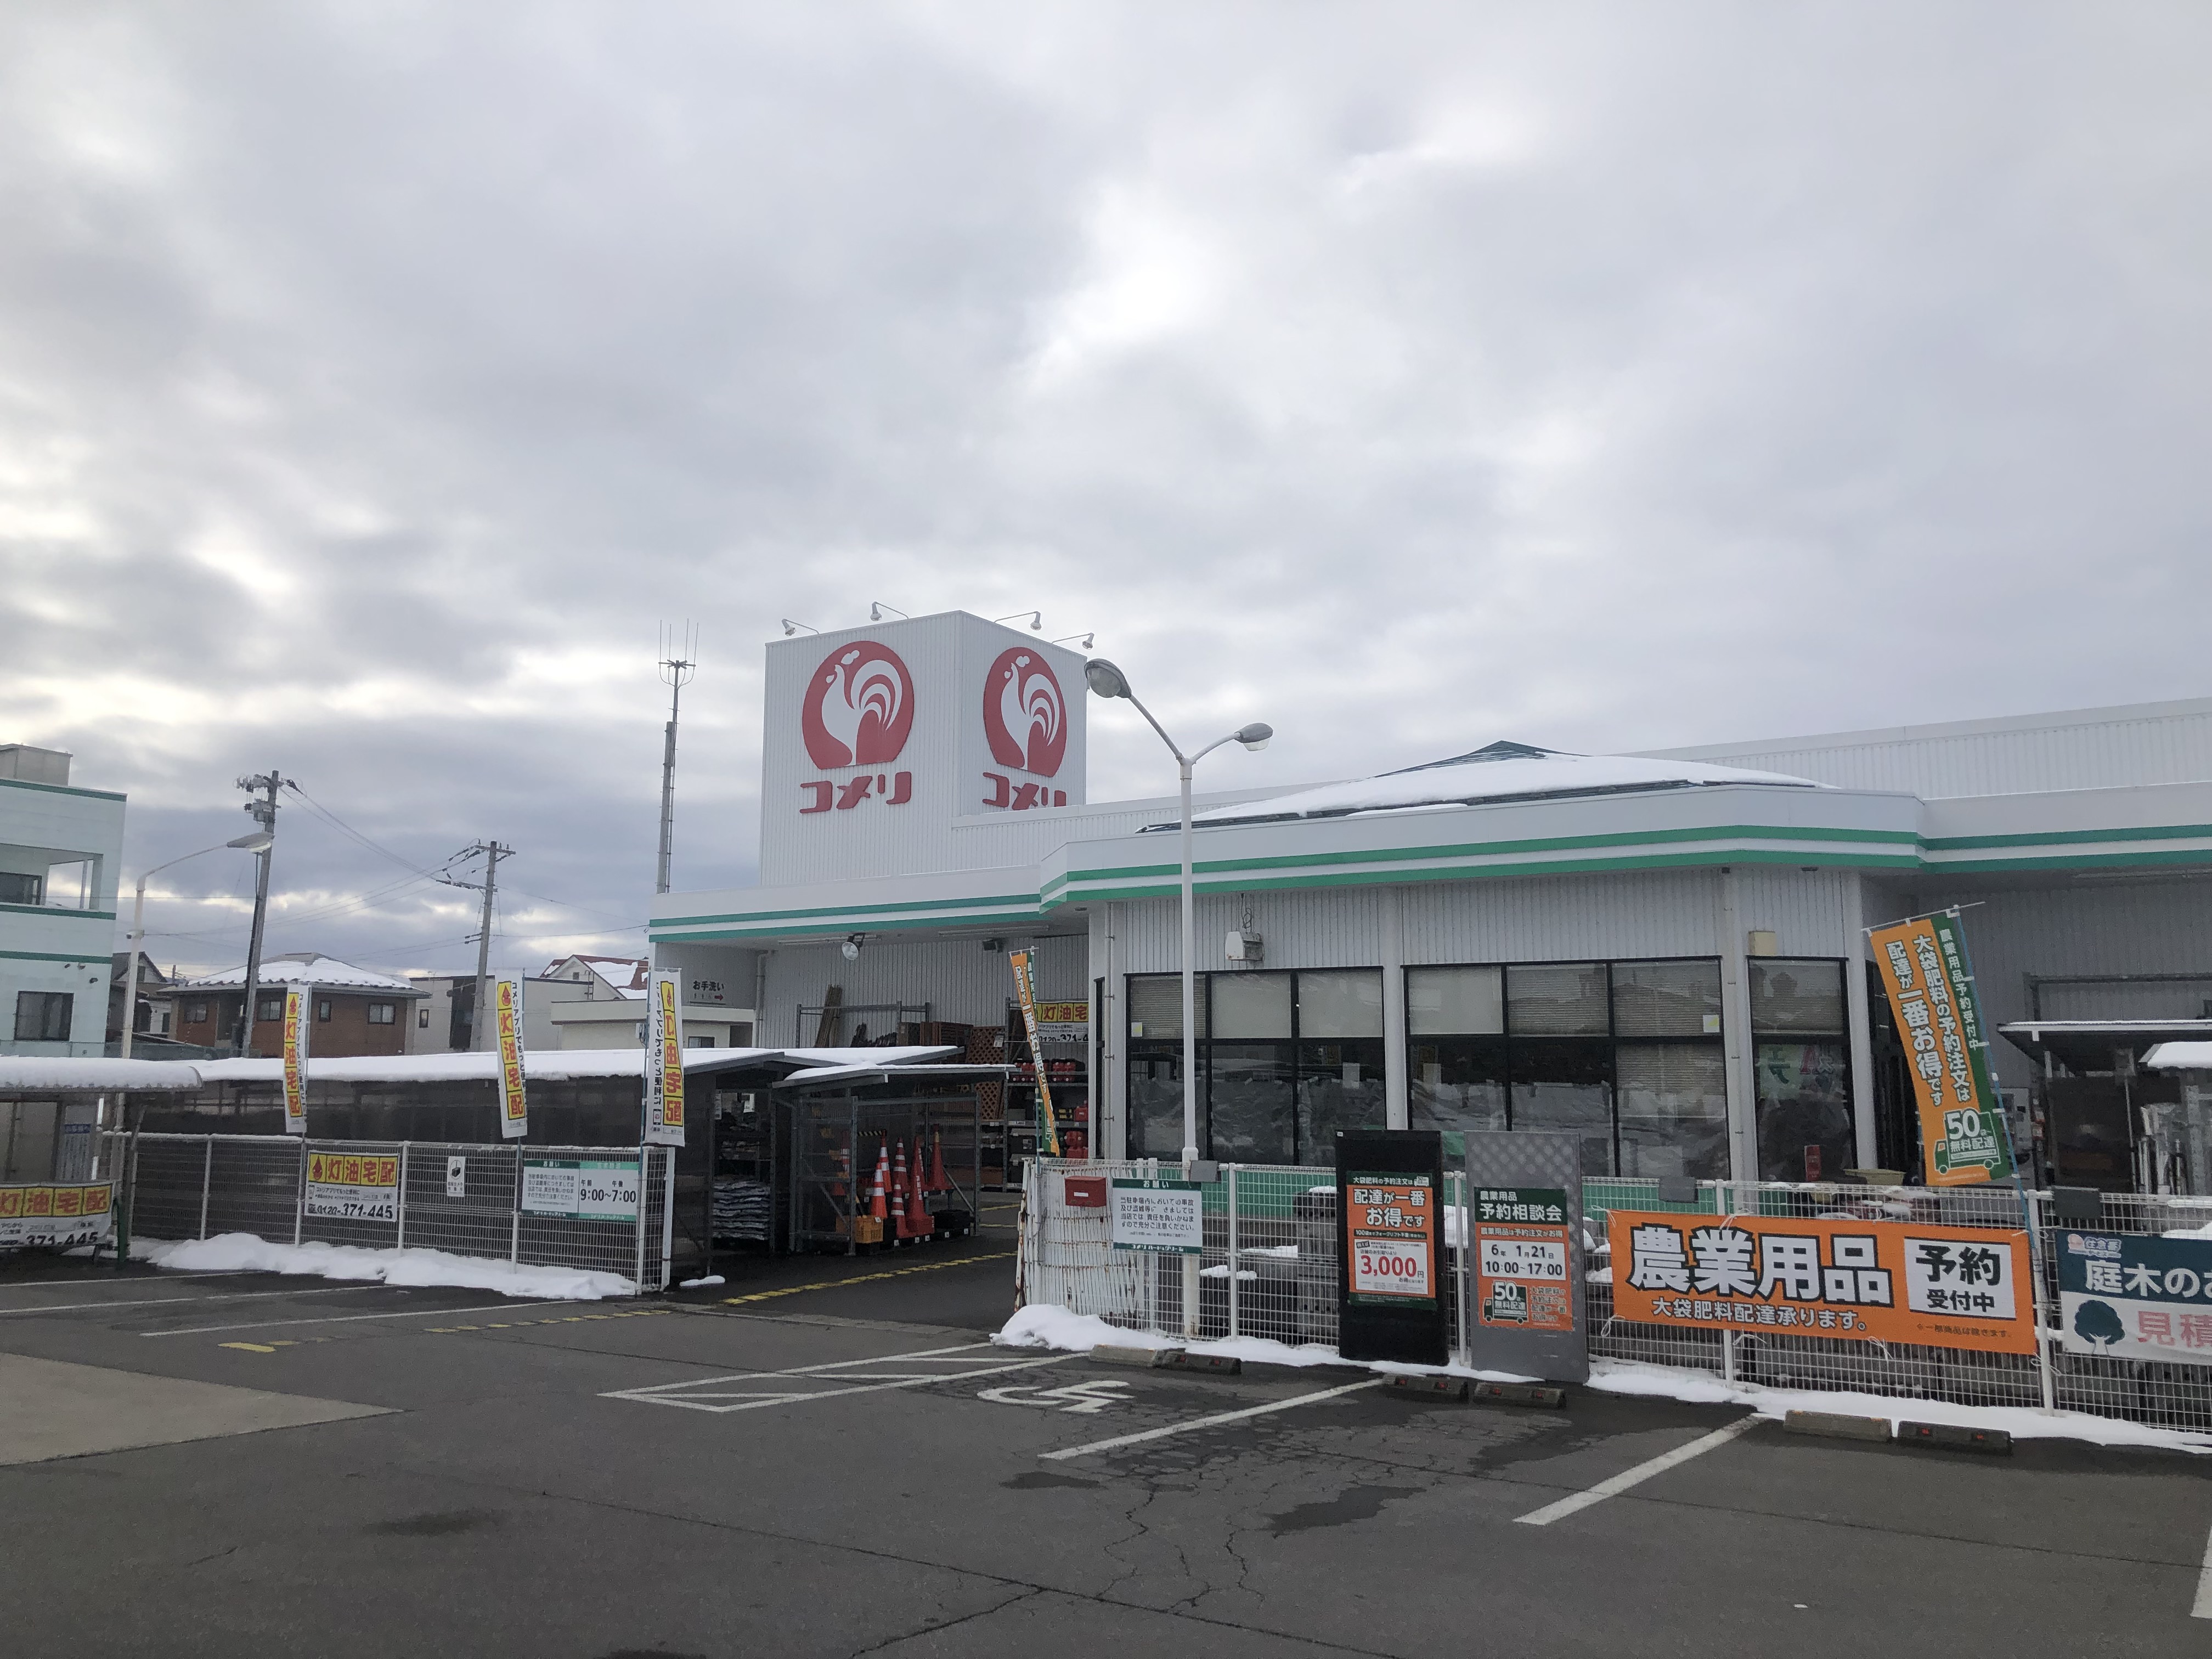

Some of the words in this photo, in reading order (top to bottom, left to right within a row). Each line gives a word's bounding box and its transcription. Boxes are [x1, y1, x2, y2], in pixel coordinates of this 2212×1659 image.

[799, 771, 912, 814] コメリ
[982, 772, 1066, 810] コメリ
[693, 980, 724, 991] お手洗い
[1886, 940, 1943, 1107] 配達が一番お得です
[1913, 934, 1971, 1103] 大袋肥料の予約注文は
[285, 1020, 300, 1114] 灯油宅配
[500, 1013, 523, 1116] 灯油宅配
[1950, 1136, 1995, 1153] 無料配達
[328, 1158, 395, 1183] 灯油宅配
[1353, 1176, 1413, 1185] 大袋肥料の予約注文は
[1143, 1180, 1169, 1188] お願い
[1480, 1190, 1517, 1201] 農業用品
[0, 1189, 109, 1215] 灯油宅配
[1354, 1188, 1425, 1206] 配達が一番
[1367, 1207, 1425, 1227] お得です
[1480, 1203, 1562, 1221] 予約相談会
[1481, 1227, 1563, 1238] 農業用品は予約注文がお得
[1628, 1223, 1893, 1307] 農業用品
[1915, 1244, 2001, 1286] 予約
[2085, 1260, 2212, 1299] 庭木の
[1926, 1289, 1995, 1312] 受付中
[1652, 1296, 1867, 1331] 大袋肥料配達承ります。
